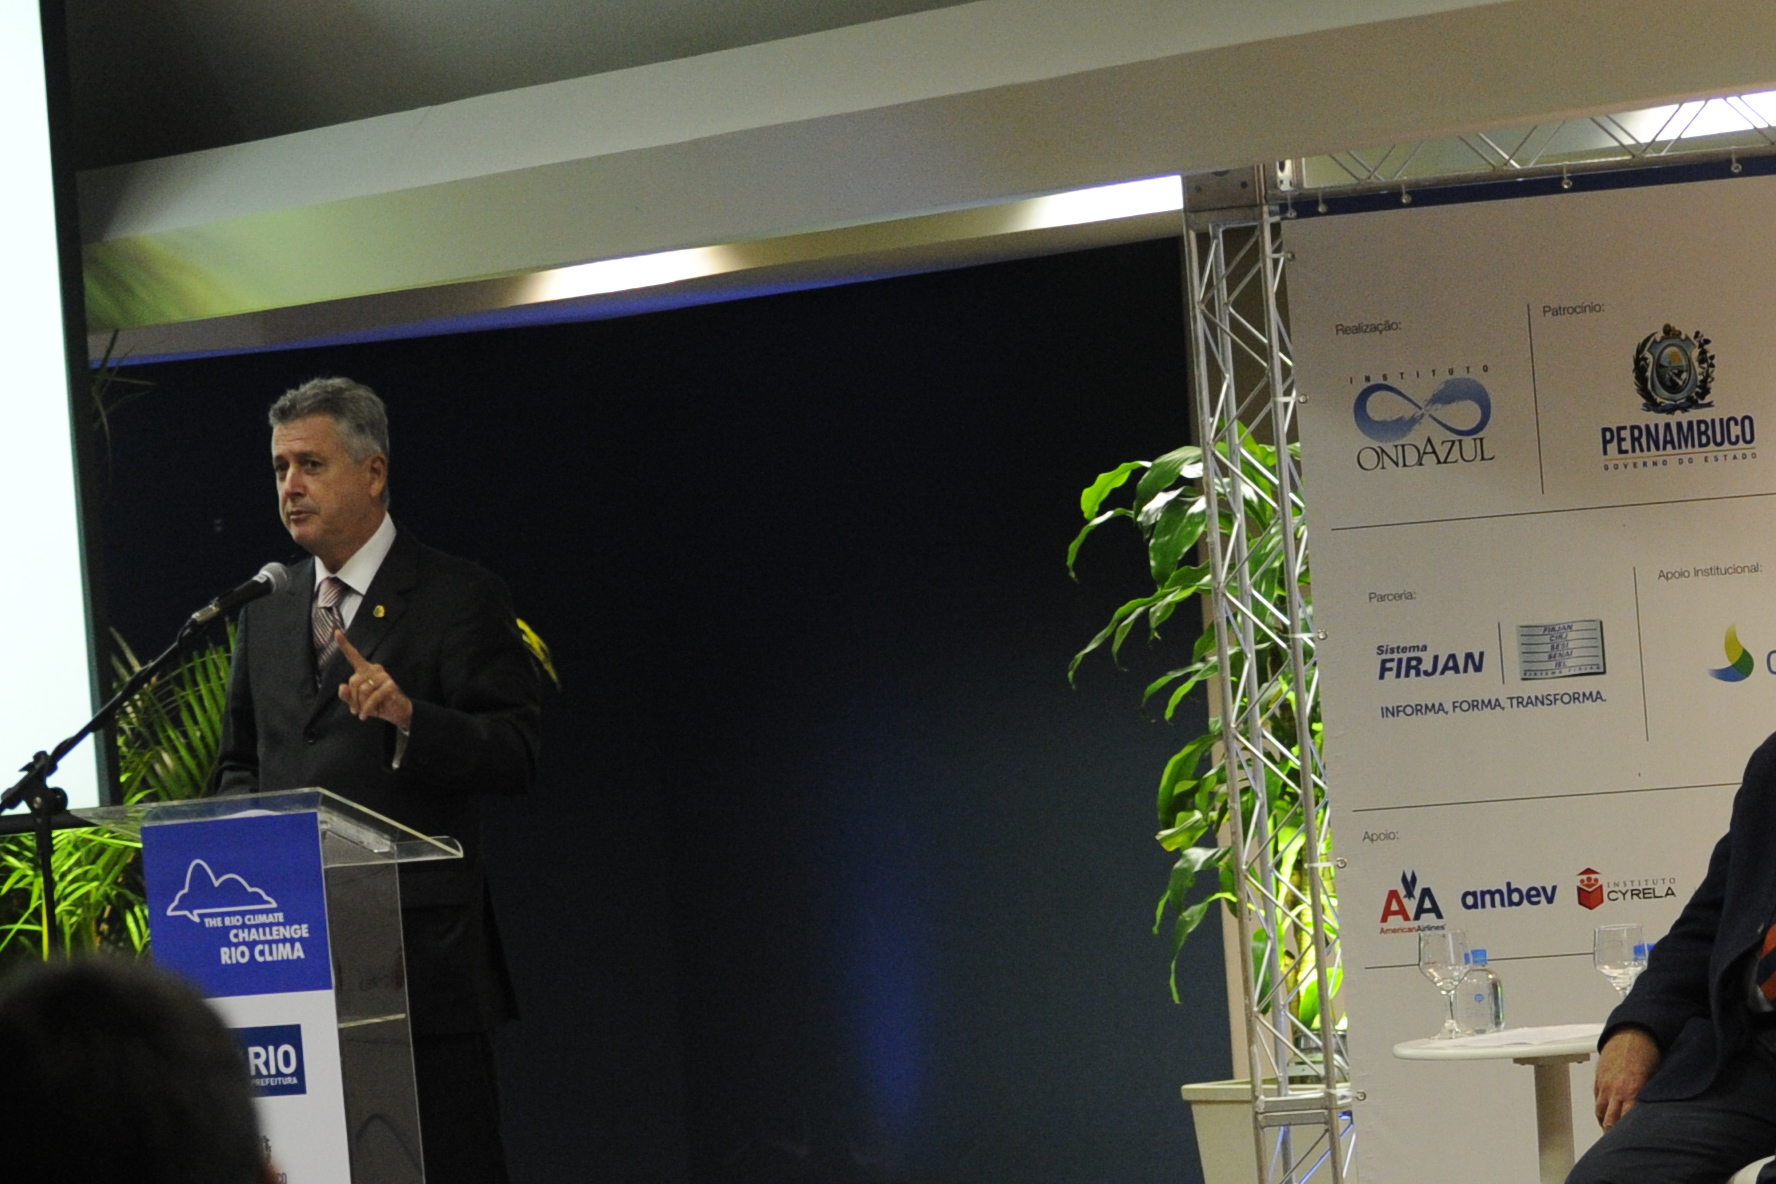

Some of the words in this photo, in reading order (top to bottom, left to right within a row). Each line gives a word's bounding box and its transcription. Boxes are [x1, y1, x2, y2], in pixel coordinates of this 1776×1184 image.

[1542, 301, 1605, 317] Patrocínio:
[1335, 320, 1402, 336] Realização:
[1350, 364, 1489, 385] INSTITUTO
[1601, 415, 1755, 456] PERNAMBUCO
[1357, 436, 1495, 471] ONDAZUL
[1603, 459, 1669, 471] GOVERNO
[1678, 457, 1694, 466] DO
[1704, 452, 1758, 463] ESTADO
[1658, 569, 1691, 582] Apoio
[1693, 562, 1763, 577] Institucional:
[1368, 590, 1417, 603] Parceria:
[1376, 643, 1428, 656] Sistema
[1378, 650, 1485, 681] FIRJAN
[1381, 702, 1449, 719] INFORMA,
[1452, 697, 1505, 713] FORMA,
[1507, 690, 1607, 709] TRANSFORMA.
[1362, 830, 1400, 845] Apoio:
[1606, 877, 1676, 889] INSTITUTO
[1461, 881, 1558, 911] ambev
[1606, 886, 1677, 902] CYRELA
[204, 917, 223, 928] THE
[224, 915, 243, 926] RIO
[244, 912, 285, 925] CLIMATE
[229, 923, 310, 943] CHALLENGE
[220, 945, 250, 965] RIO
[254, 941, 305, 962] CLIMA
[247, 1044, 297, 1076] RIO
